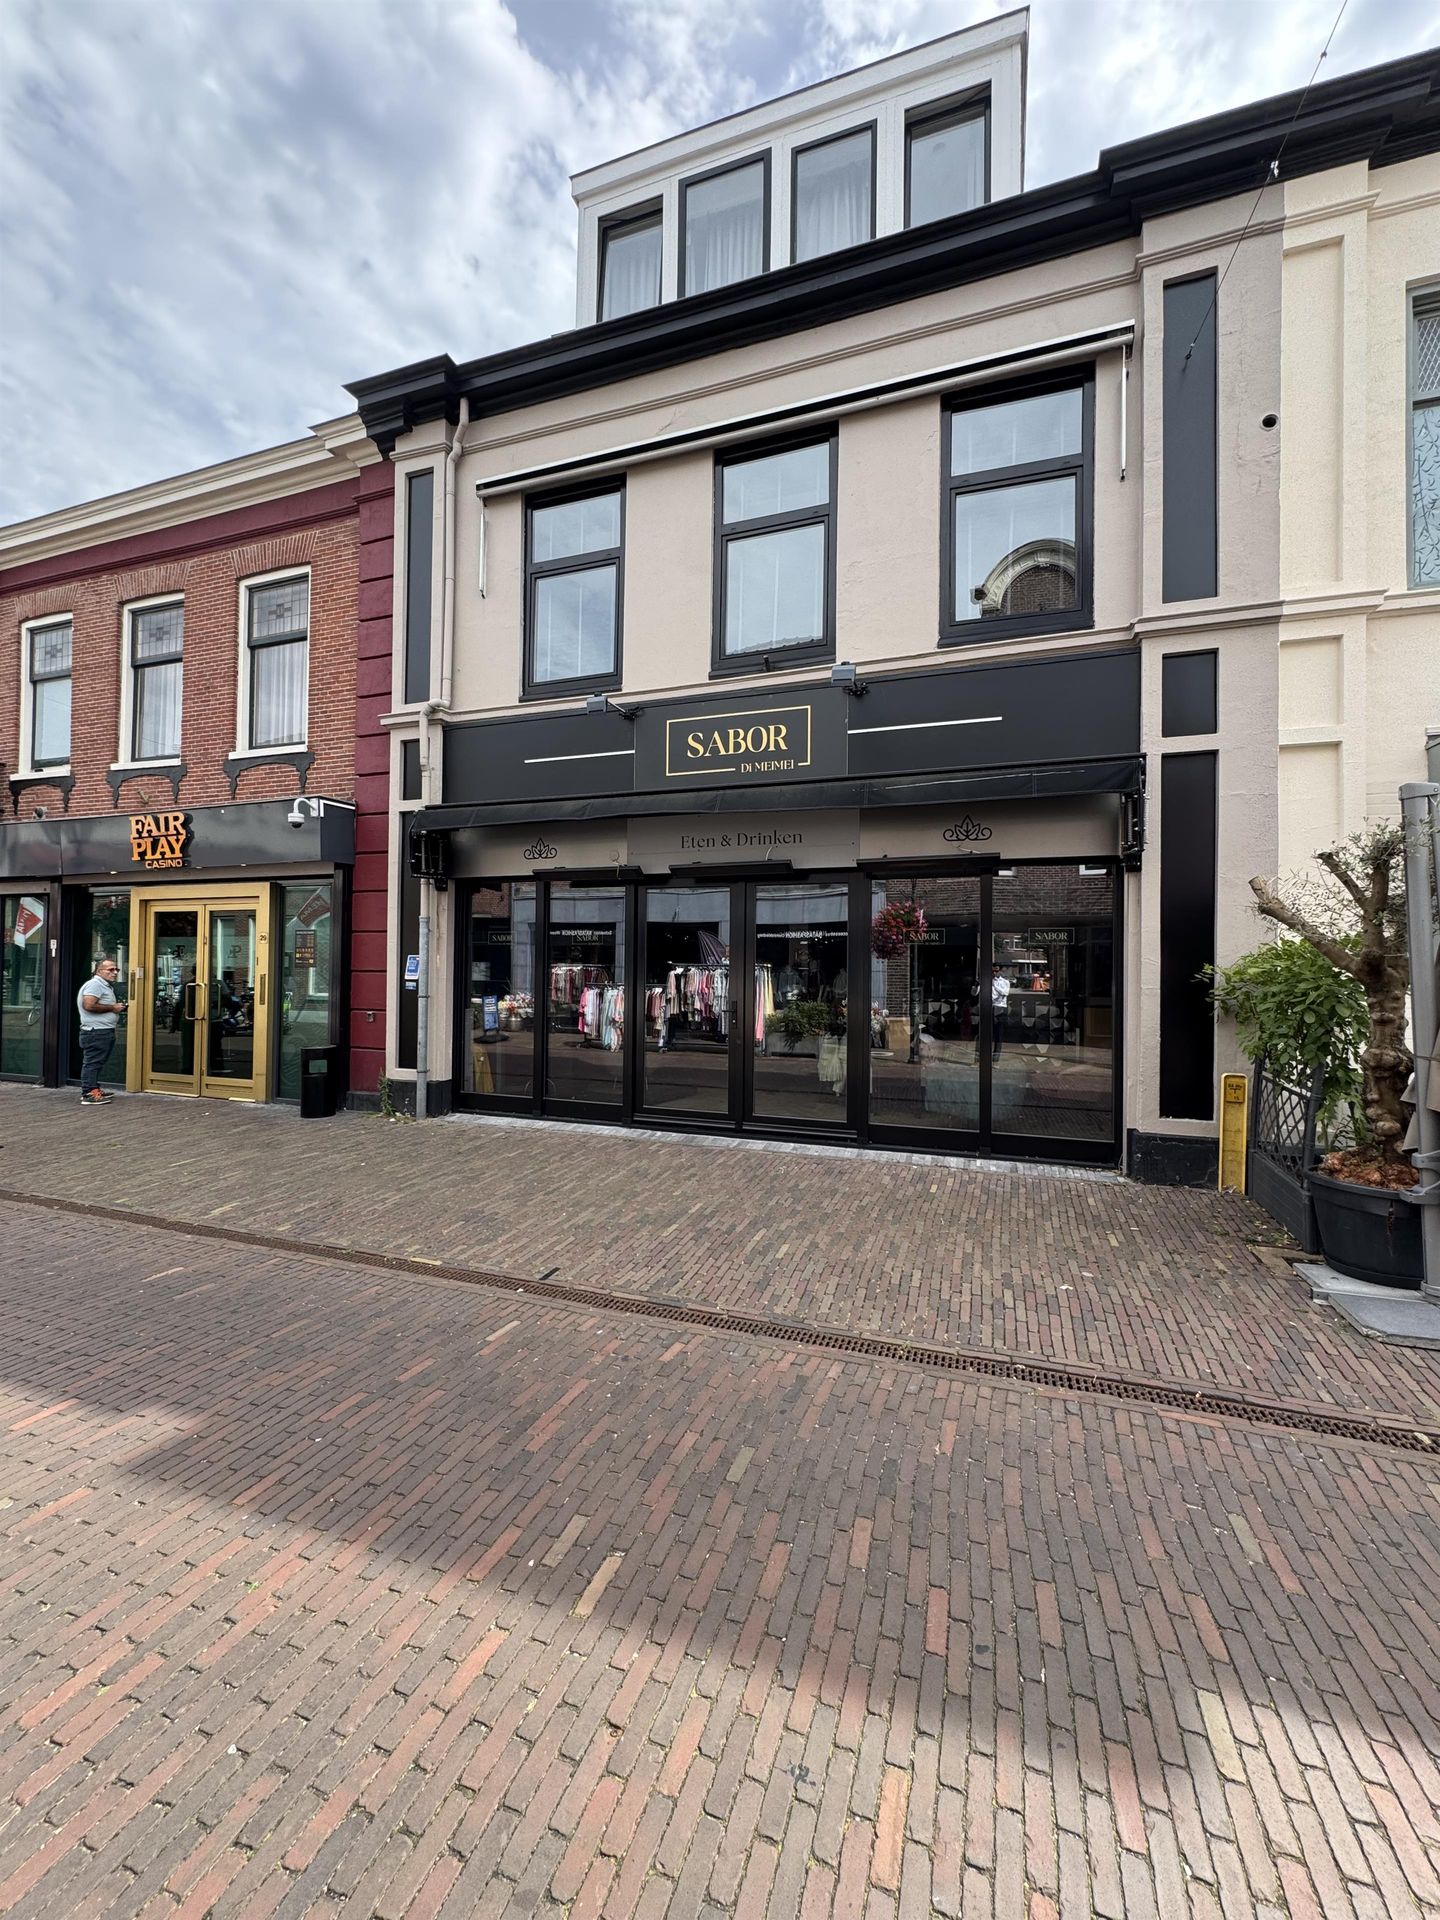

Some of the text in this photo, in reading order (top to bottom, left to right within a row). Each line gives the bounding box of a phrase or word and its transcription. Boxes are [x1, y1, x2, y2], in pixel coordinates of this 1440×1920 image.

[687, 724, 788, 758] SABOR
[755, 760, 795, 772] MEIMEI
[129, 811, 186, 837] FAIR
[681, 829, 803, 849] Eten & Drinken
[131, 835, 186, 861] PLAY
[145, 859, 183, 869] CASINO
[909, 932, 939, 941] SABOR
[1034, 931, 1068, 940] SABOR
